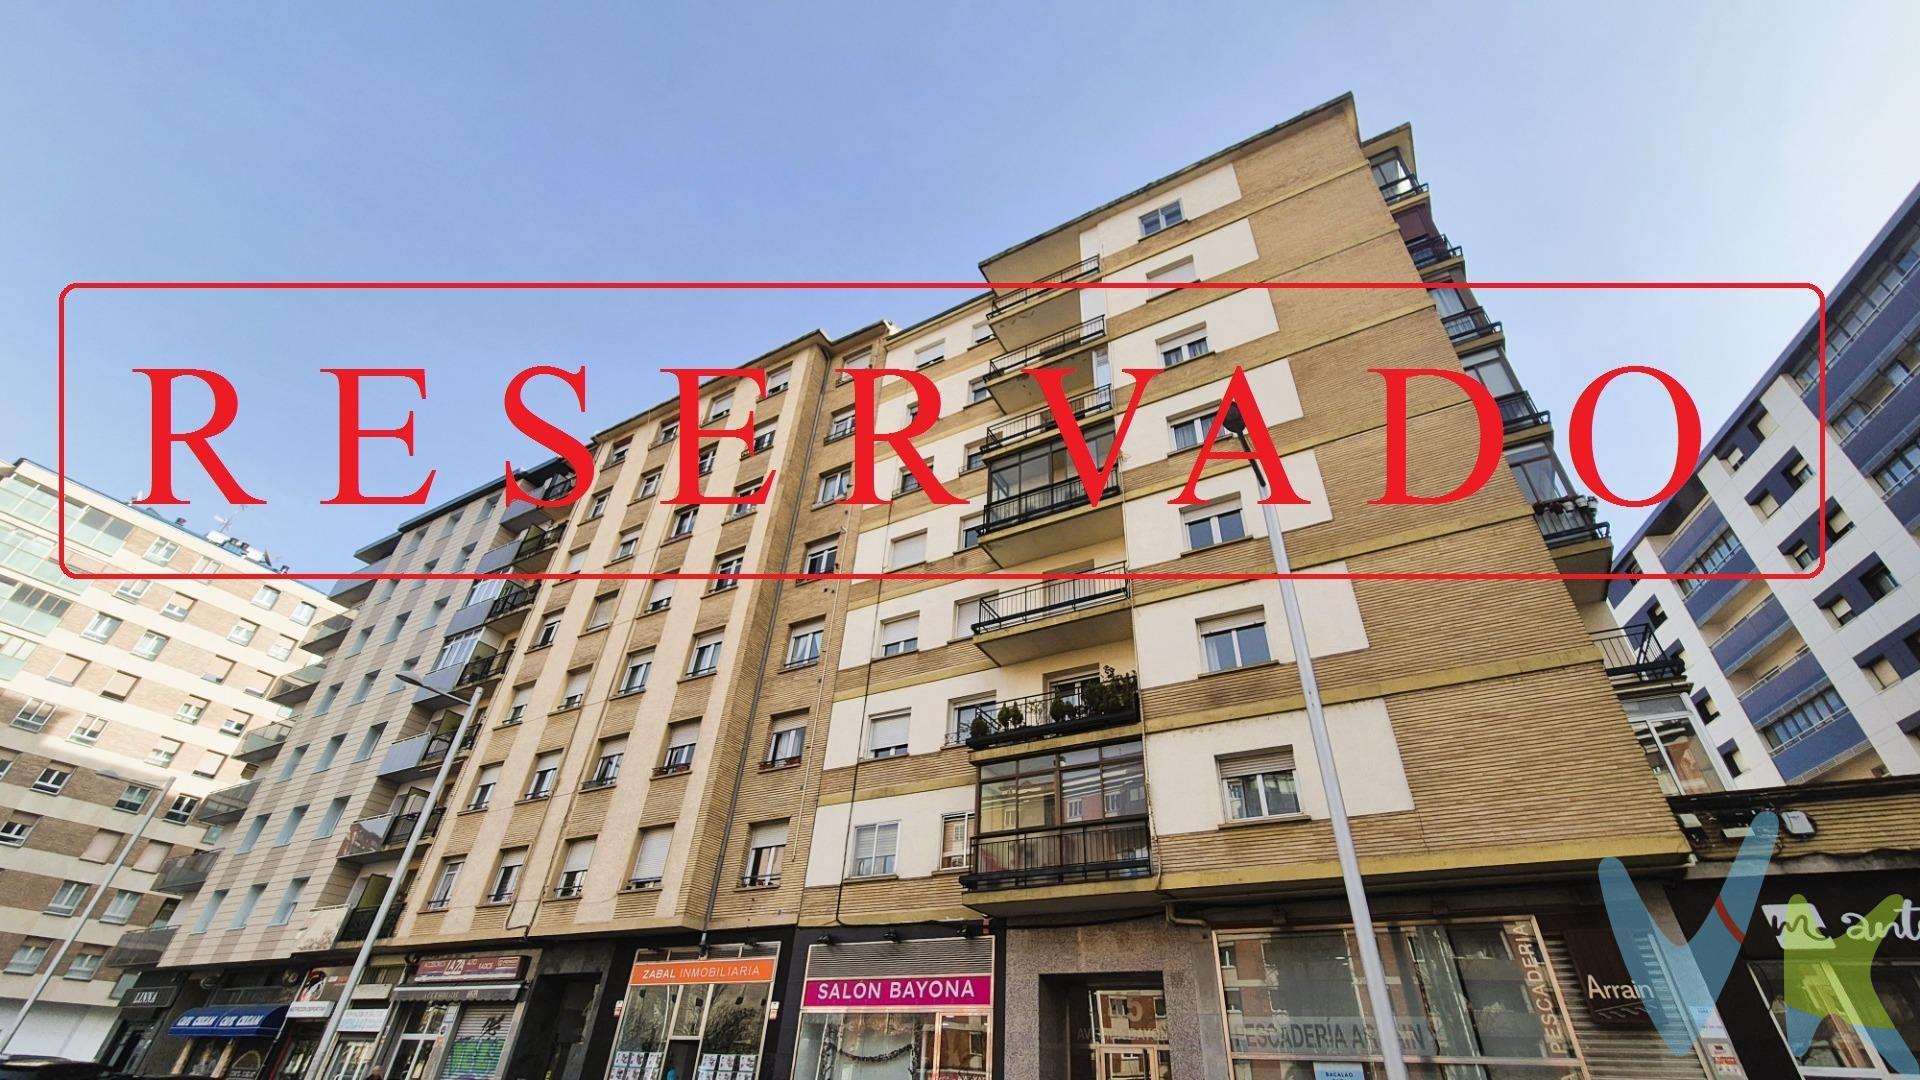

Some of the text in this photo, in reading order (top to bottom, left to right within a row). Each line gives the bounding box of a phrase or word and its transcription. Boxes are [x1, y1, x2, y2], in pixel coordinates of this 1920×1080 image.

[642, 965, 761, 980] ZABAL INMOBILIARIA
[817, 980, 975, 1000] SALÓN BAYONA
[1586, 974, 1655, 999] Arrain
